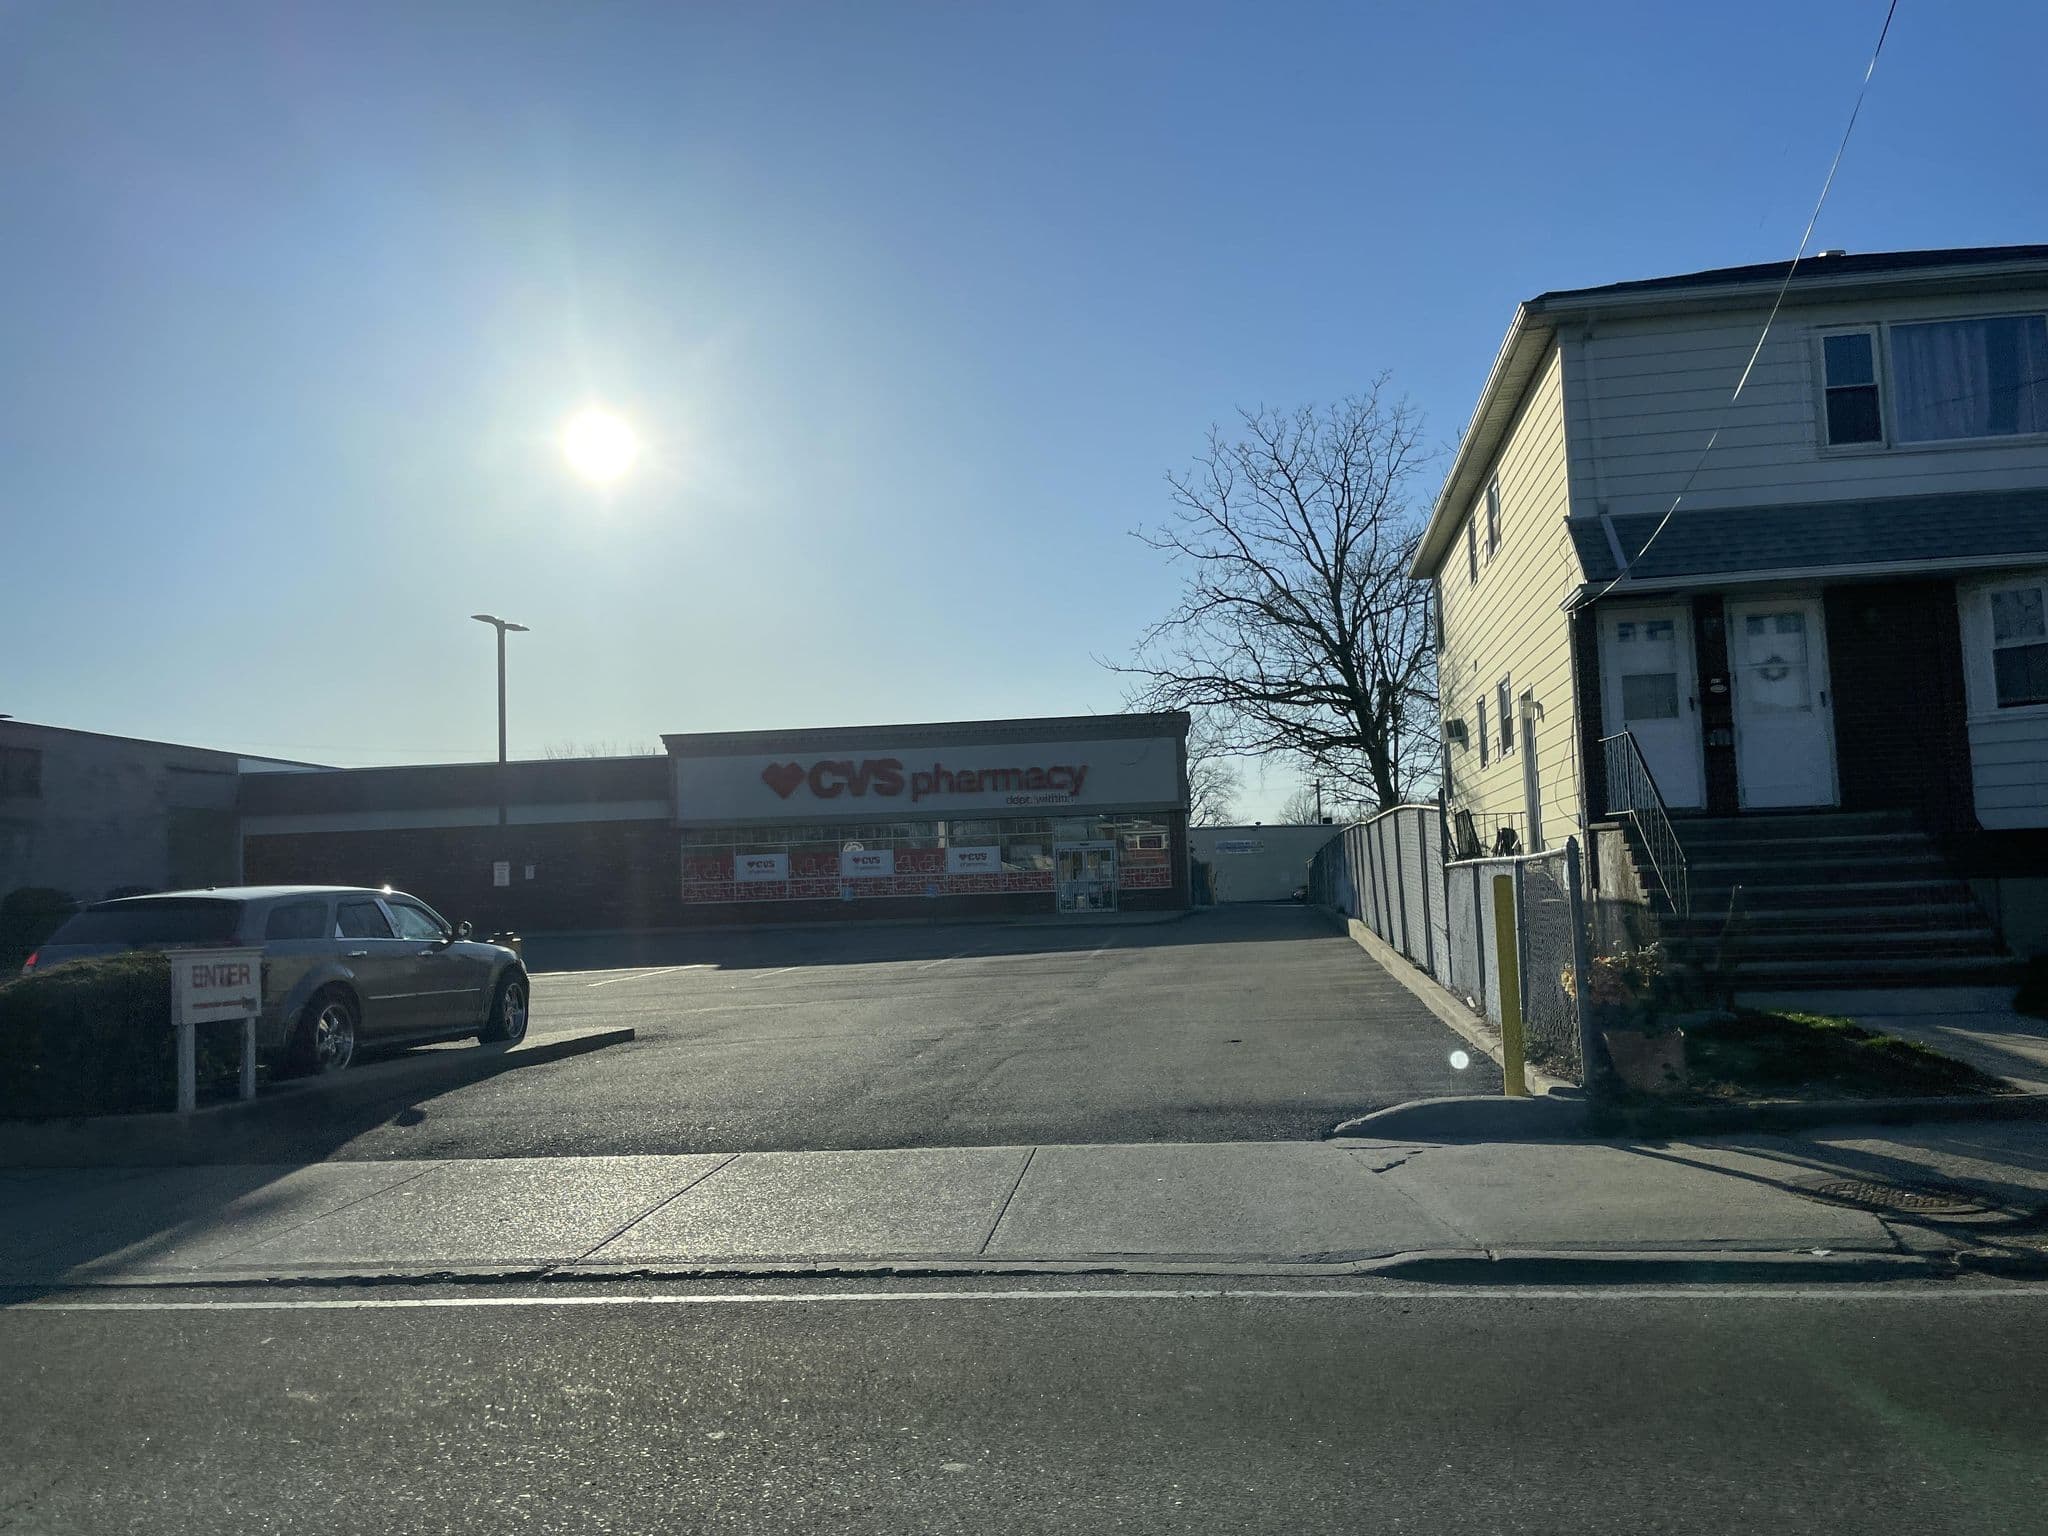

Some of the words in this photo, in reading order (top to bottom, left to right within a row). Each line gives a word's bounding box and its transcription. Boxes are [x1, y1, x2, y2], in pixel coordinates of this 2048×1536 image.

[809, 758, 904, 798] CVS
[911, 763, 1088, 802] pharmacy
[862, 856, 880, 864] CVS
[968, 852, 987, 861] CVS
[757, 860, 775, 869] CVS
[192, 964, 250, 988] ENTER
